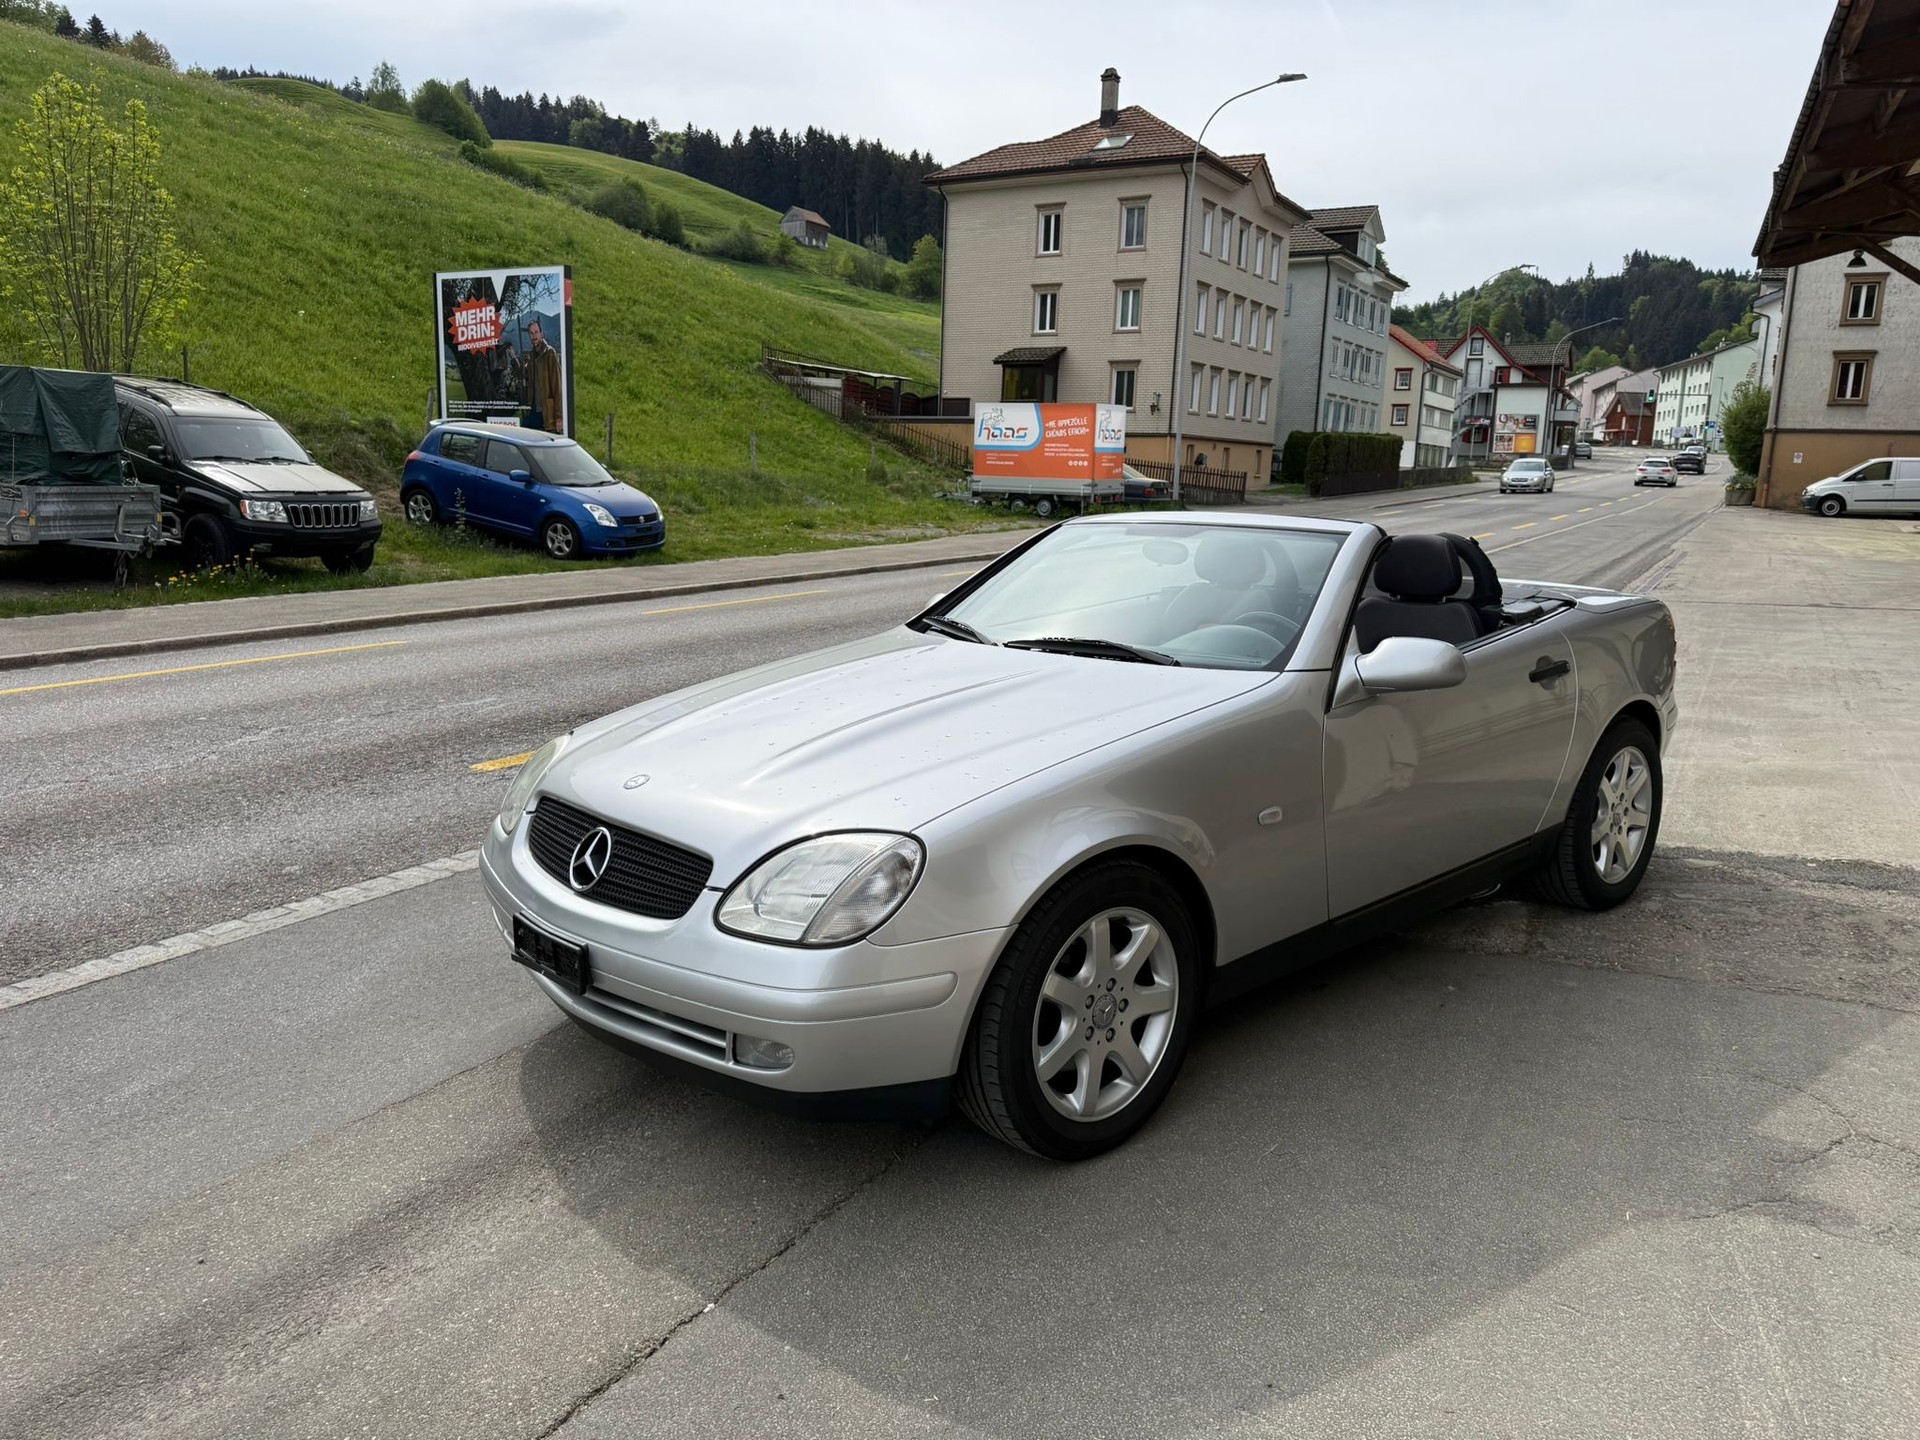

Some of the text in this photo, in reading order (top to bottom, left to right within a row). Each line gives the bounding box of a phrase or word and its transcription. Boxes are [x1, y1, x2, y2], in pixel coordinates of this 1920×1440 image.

[455, 305, 495, 326] MEHR
[457, 322, 495, 342] DRIN:
[457, 338, 499, 351] BIODIVERSITÄT
[978, 418, 1028, 441] haas
